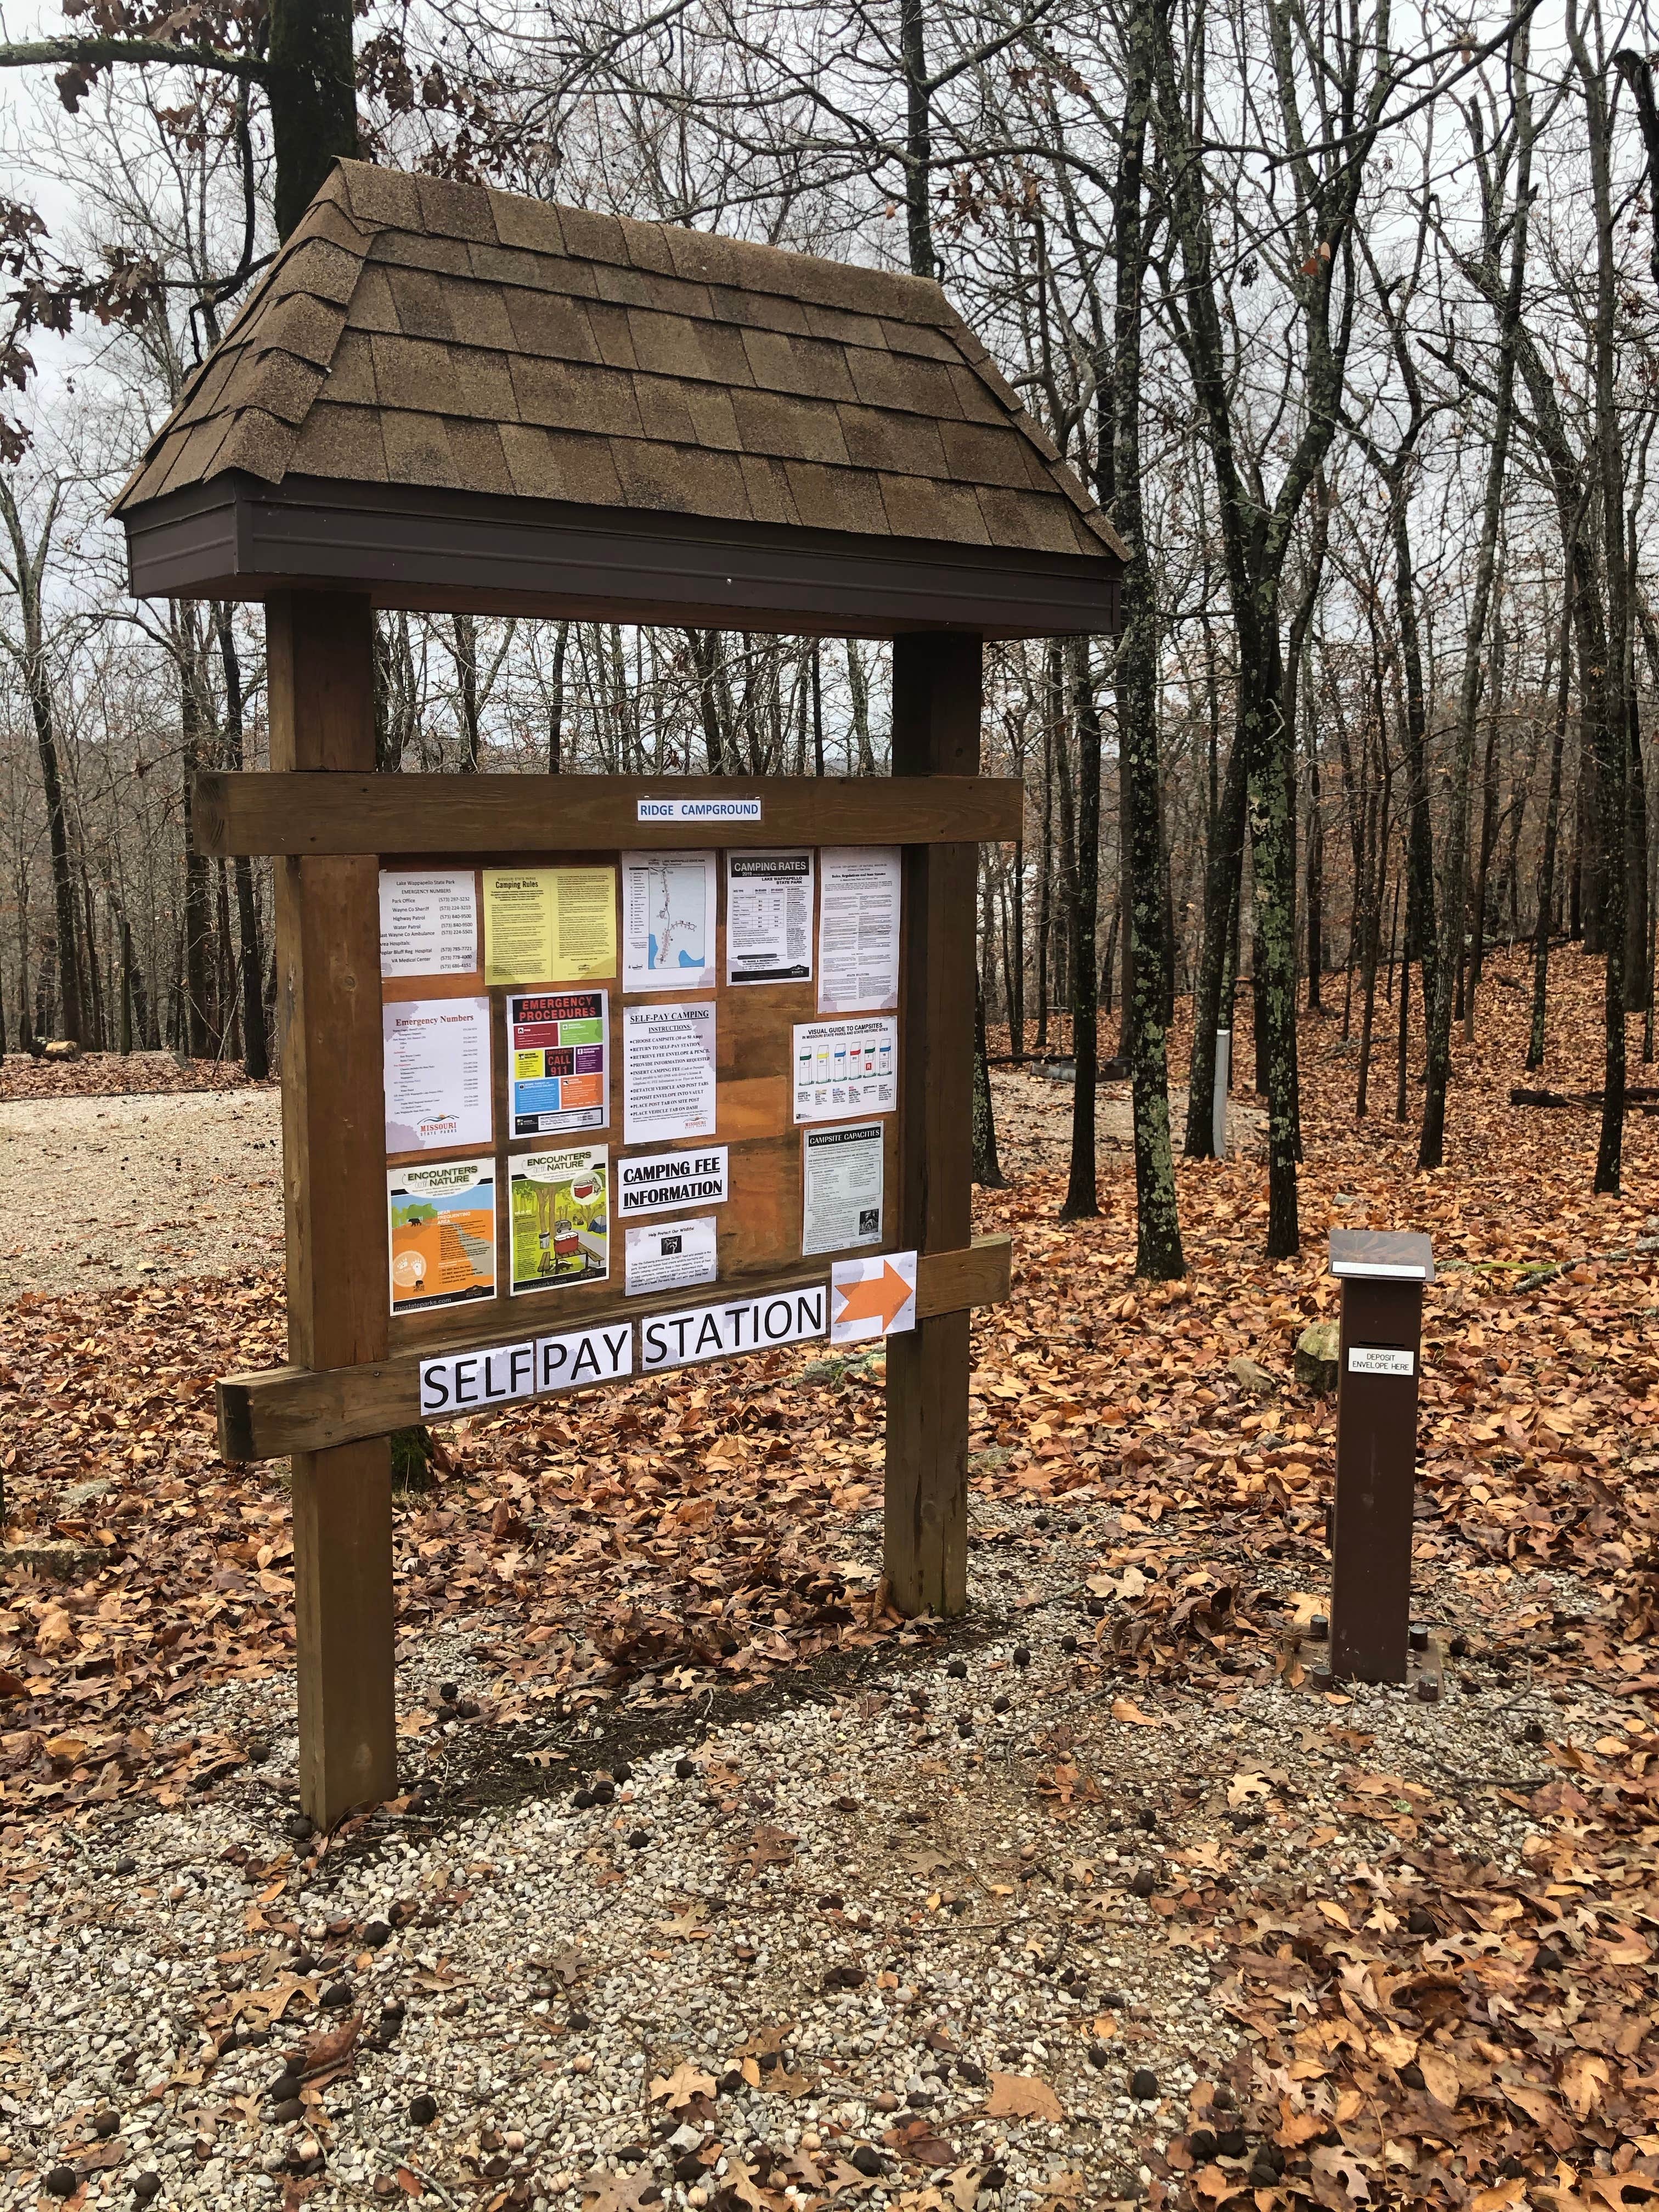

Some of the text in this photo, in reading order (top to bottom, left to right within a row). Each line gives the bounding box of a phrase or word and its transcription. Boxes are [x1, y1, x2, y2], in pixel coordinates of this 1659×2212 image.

[640, 804, 758, 815] RIDGE CAMPGROUND
[734, 861, 806, 872] CAMPING RATES
[495, 881, 521, 889] Camping
[522, 996, 592, 1010] EMERGENCY
[396, 1014, 474, 1026] Emergency Numbers
[519, 1007, 596, 1022] PROCEDURES
[630, 1010, 709, 1023] SELF-PAY CAMPING
[648, 1024, 692, 1032] INSTRUCTIONS:
[548, 1055, 571, 1066] CALL
[551, 1066, 567, 1075] 911
[420, 1122, 456, 1132] MISSOURI
[810, 1129, 879, 1144] CAMPSITE CAPACITIES
[527, 1152, 591, 1166] ENCOUNTERS
[547, 1160, 584, 1171] NATURE
[623, 1156, 720, 1183] CAMPING FEE
[408, 1166, 478, 1181] ENCOUNTERS
[430, 1175, 469, 1186] NATURE
[624, 1179, 723, 1207] INFORMATION
[437, 1211, 471, 1220] FREQUENTING
[515, 1278, 567, 1291] mostateparks.com
[395, 1297, 452, 1311] mostateparks.com
[424, 1293, 821, 1409] SELF PAY STATION
[1367, 1353, 1396, 1361] DEPOSIT
[1352, 1361, 1389, 1369] ENVELOPE
